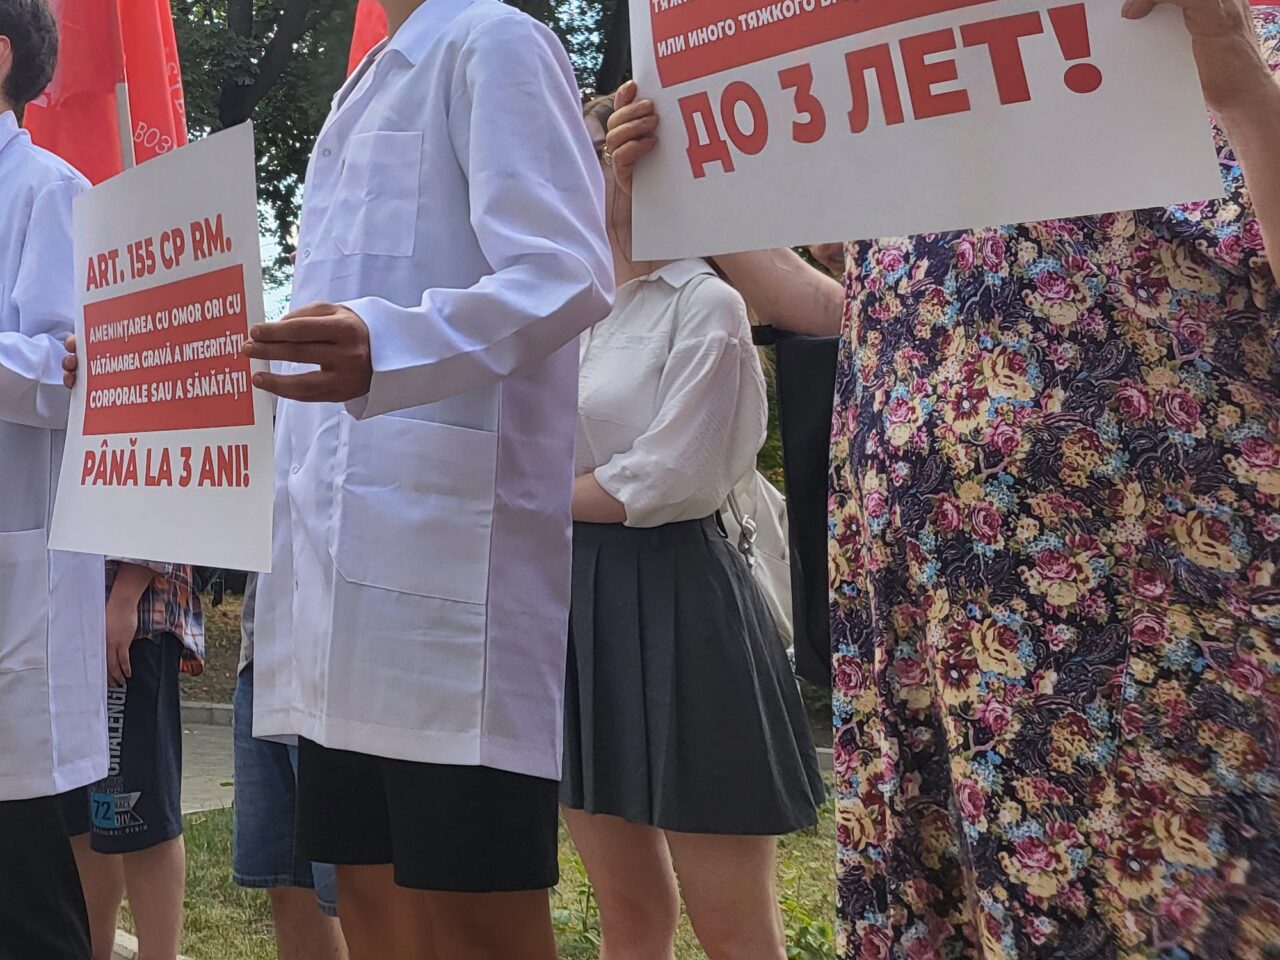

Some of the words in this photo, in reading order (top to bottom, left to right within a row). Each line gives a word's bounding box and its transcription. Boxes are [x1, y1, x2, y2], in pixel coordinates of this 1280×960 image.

[657, 34, 685, 58] ИЛИ
[688, 19, 736, 50] ИНОГО
[677, 80, 769, 180] ДО
[777, 62, 826, 144] 3
[844, 3, 1102, 135] ЛЕТ!
[86, 248, 124, 292] ART.
[127, 237, 156, 279] 155
[160, 227, 185, 270] CP
[190, 213, 232, 261] RM.
[156, 311, 169, 330] CU
[171, 302, 202, 327] OMOR
[204, 298, 224, 319] ORI
[226, 293, 241, 315] CU
[142, 342, 172, 367] GRAVĂ
[174, 345, 182, 363] A
[90, 384, 148, 409] CORPORALE
[151, 381, 173, 403] SAU
[175, 380, 184, 399] A
[80, 437, 139, 486] PÂNĂ
[144, 447, 173, 487] LA
[178, 446, 192, 488] 3
[198, 444, 250, 488] ANI!
[92, 799, 112, 821] 72
